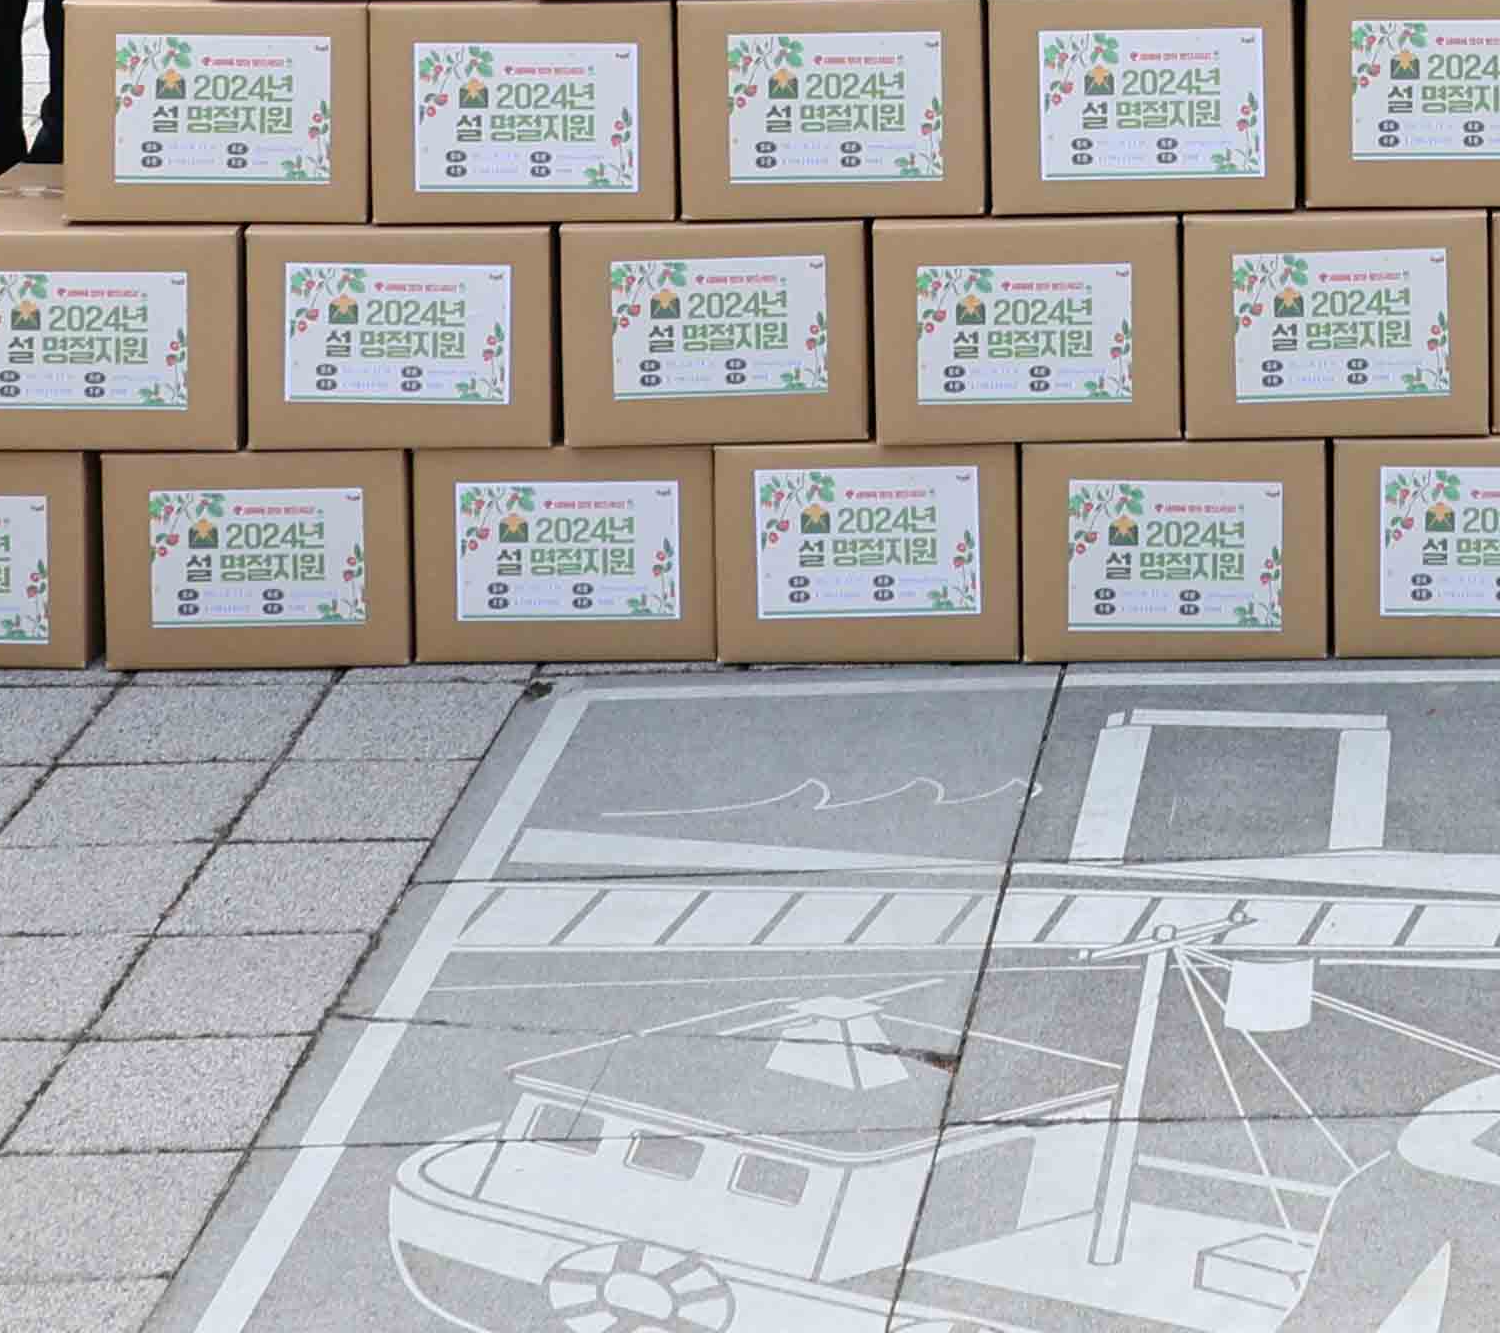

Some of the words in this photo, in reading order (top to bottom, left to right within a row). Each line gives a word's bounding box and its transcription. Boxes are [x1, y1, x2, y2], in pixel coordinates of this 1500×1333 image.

[194, 74, 293, 102] 2024년
[806, 71, 905, 101] 2024년
[1388, 86, 1415, 113] 설
[152, 106, 179, 134] 설
[187, 106, 293, 135] 명절지원
[766, 105, 792, 134] 설
[800, 103, 906, 134] 명절지원
[688, 289, 788, 320] 2024년
[1311, 287, 1411, 319] 2024년
[49, 305, 149, 332] 2024년
[9, 336, 35, 363] 설
[43, 336, 150, 364] 명절지원
[649, 325, 676, 353] 설
[682, 320, 790, 352] 명절지원
[1271, 324, 1298, 353] 설
[1305, 319, 1412, 352] 명절지원
[536, 515, 635, 544] 2024년
[1146, 520, 1245, 549] 2024년
[497, 549, 524, 576] 설
[530, 546, 637, 576] 명절지원
[1105, 553, 1132, 581] 설
[1139, 552, 1245, 581] 명절지원
